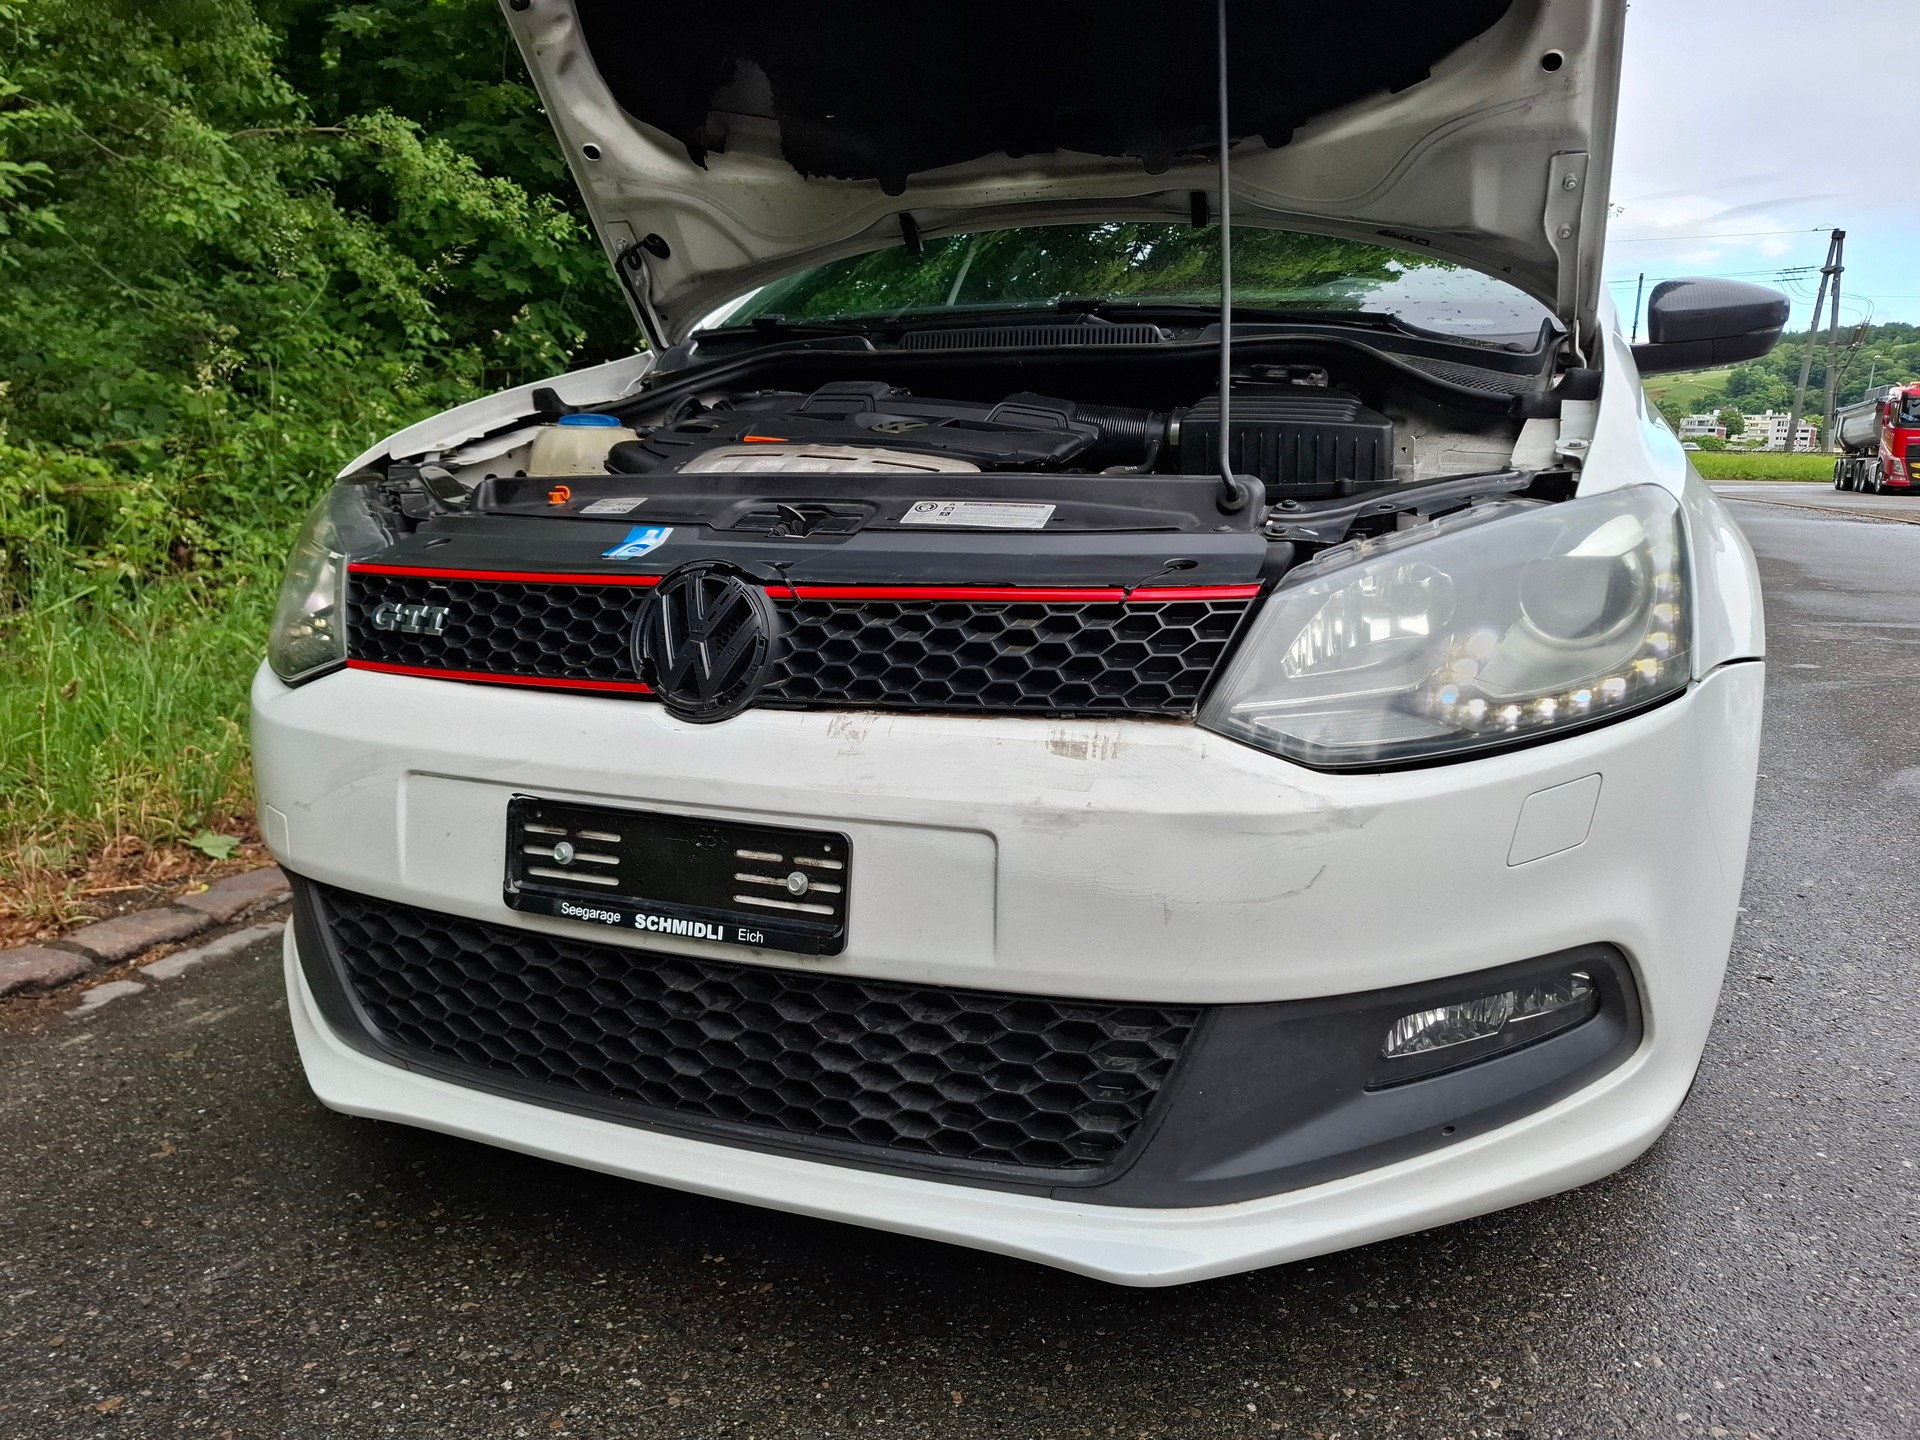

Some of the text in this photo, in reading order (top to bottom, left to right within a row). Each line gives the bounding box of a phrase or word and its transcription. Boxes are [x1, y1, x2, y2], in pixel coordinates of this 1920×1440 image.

[371, 602, 449, 636] GTI
[648, 568, 760, 699] VW
[561, 902, 764, 944] Seegarage SCHMIDLI Eich
